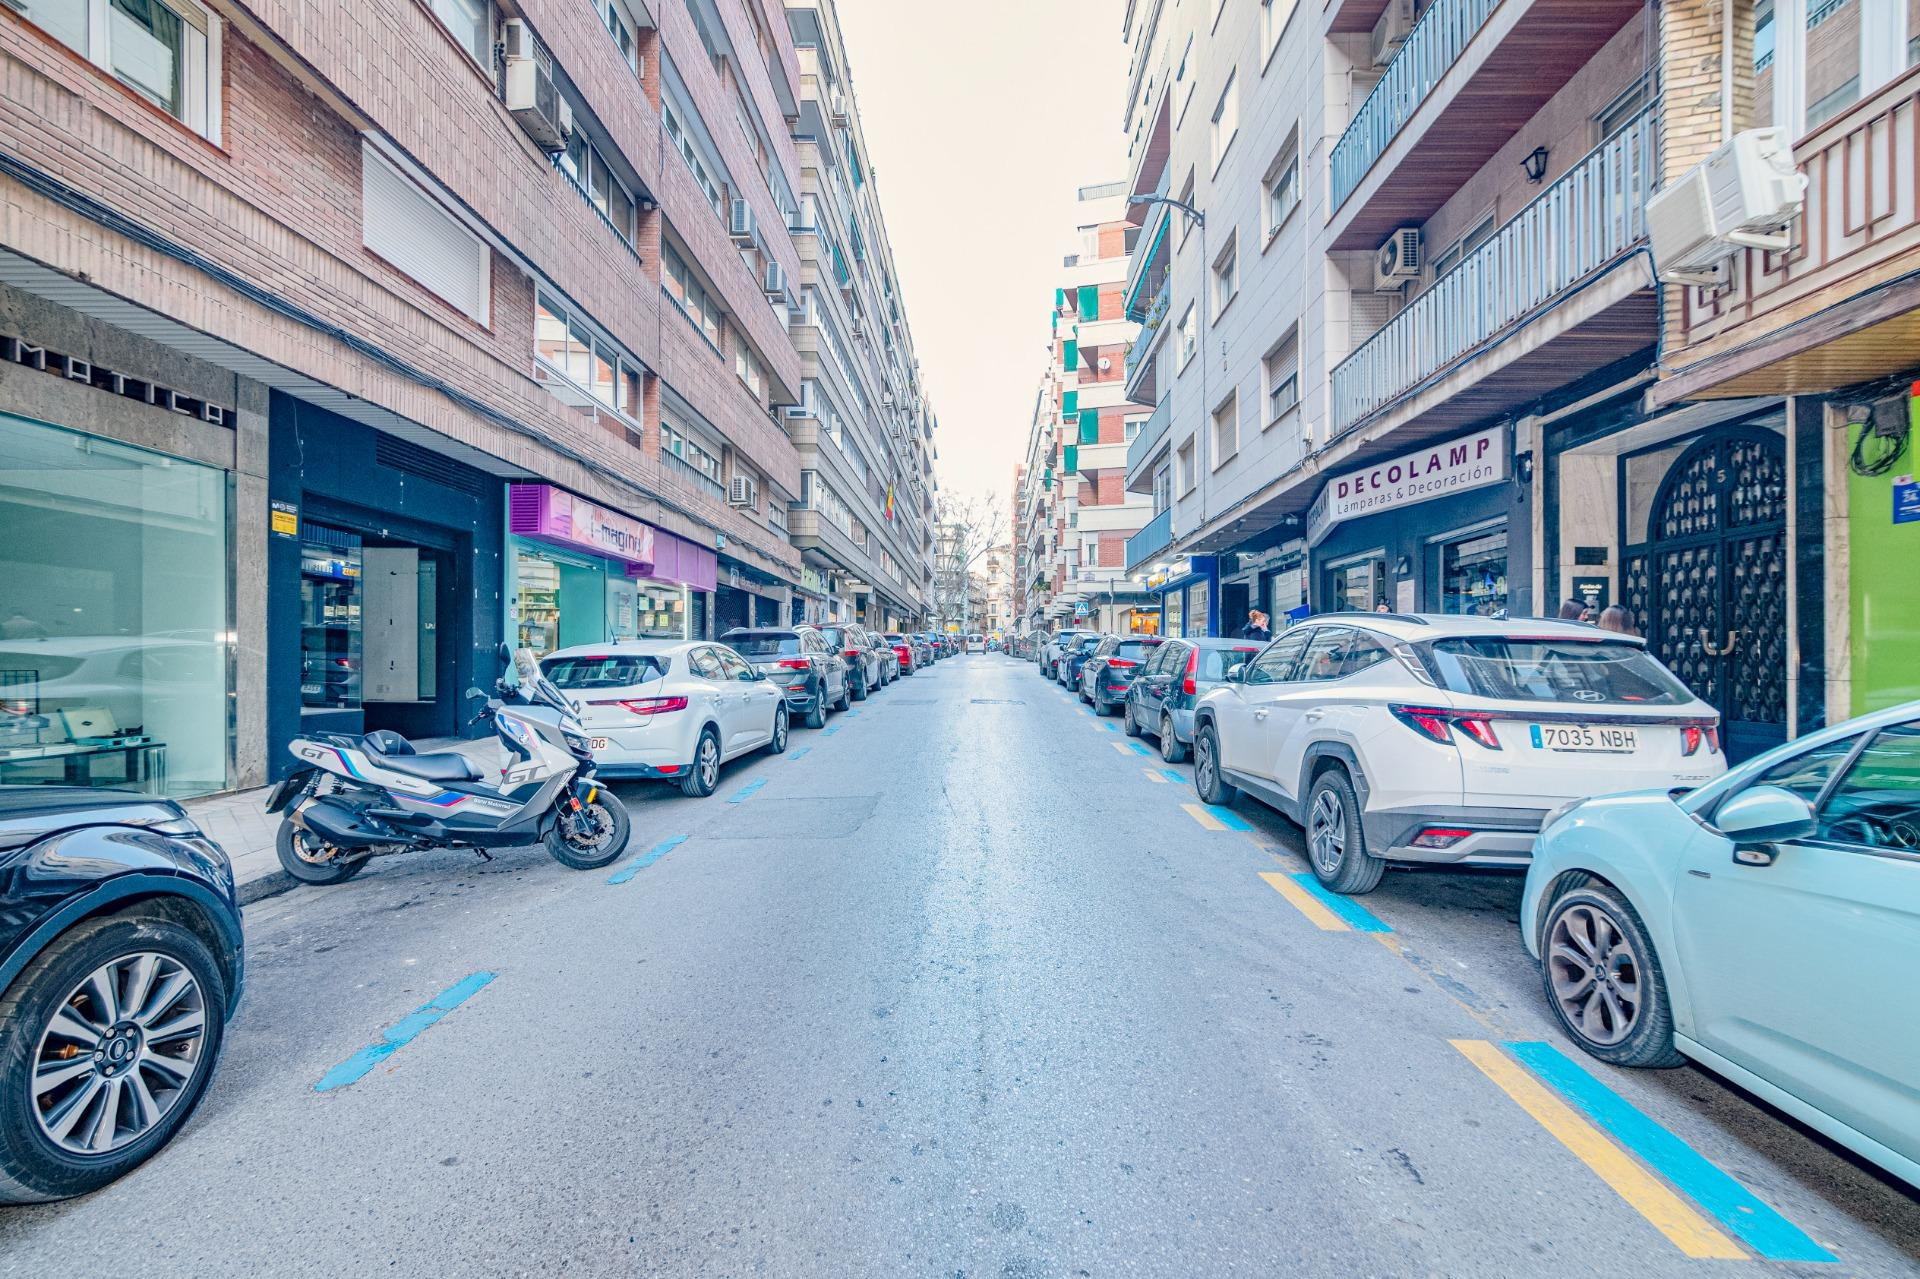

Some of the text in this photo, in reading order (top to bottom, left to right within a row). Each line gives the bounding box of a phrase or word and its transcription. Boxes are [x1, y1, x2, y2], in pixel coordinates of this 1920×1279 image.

[1337, 437, 1490, 499] DECOLAMP
[1717, 469, 1726, 483] 5
[1396, 487, 1404, 499] &
[1408, 464, 1492, 497] Decoración
[1545, 729, 1636, 748] 7035 NBH
[301, 747, 332, 760] GT
[506, 764, 547, 784] GT
